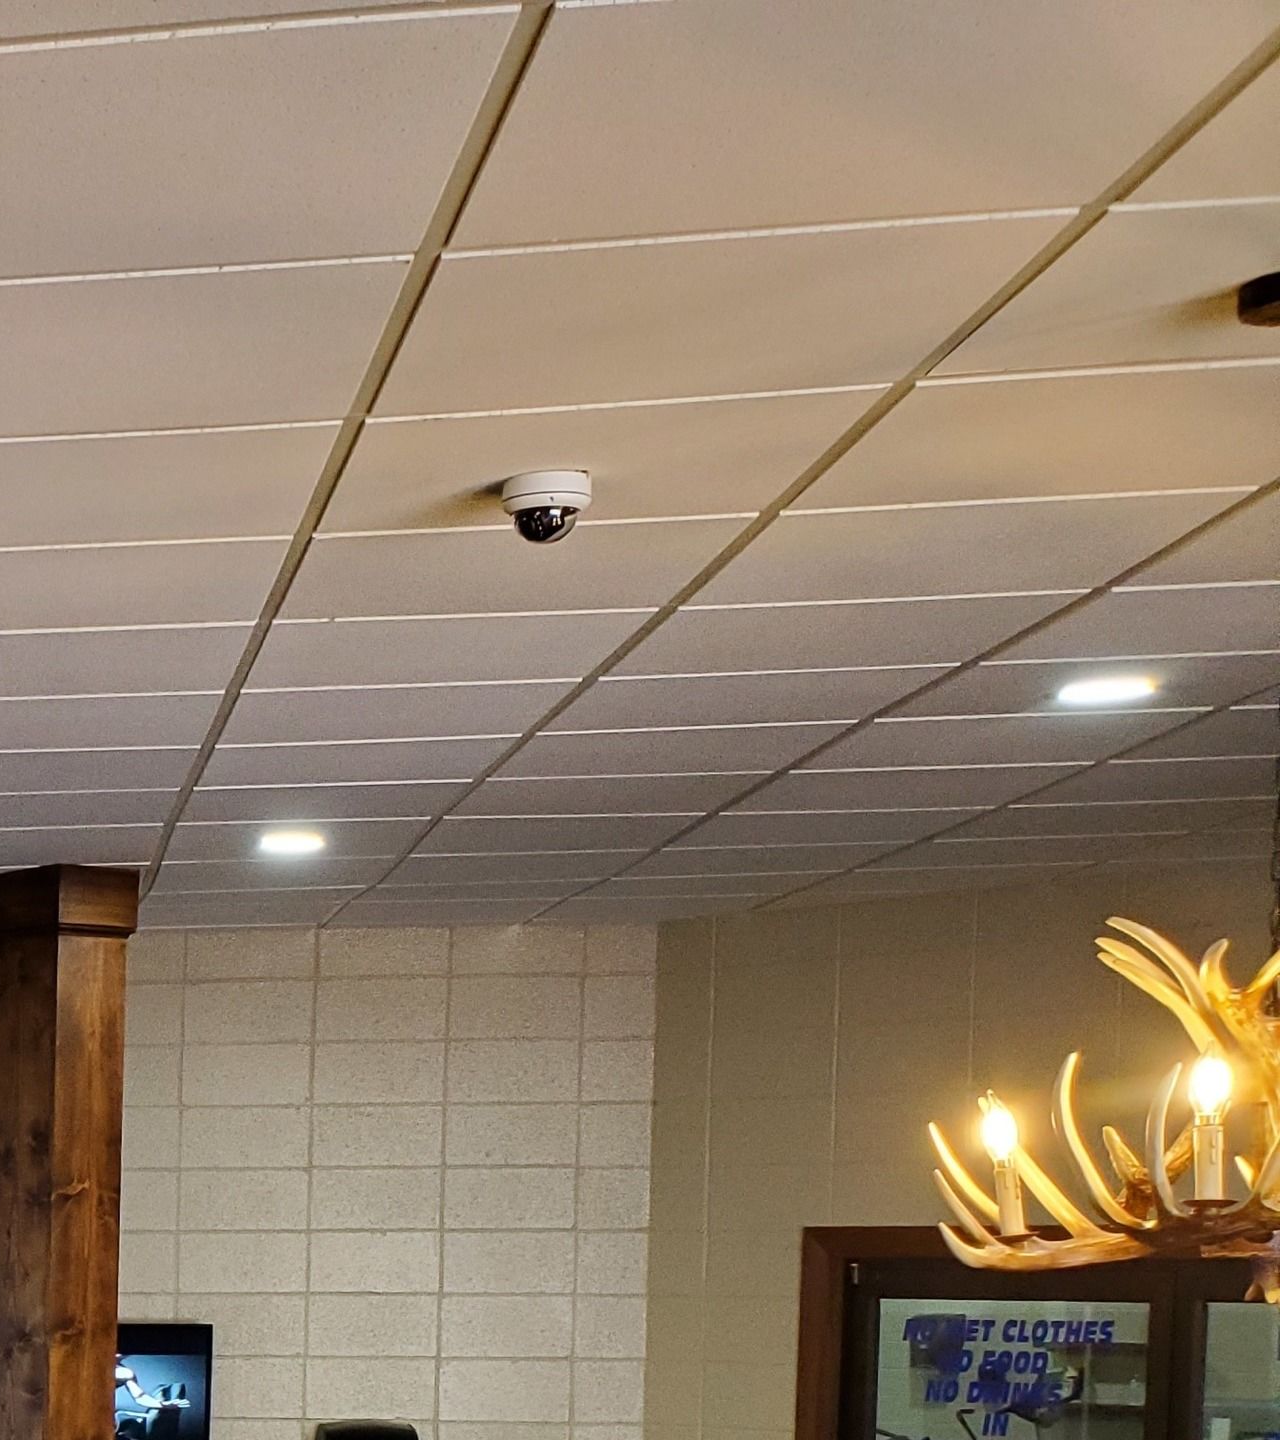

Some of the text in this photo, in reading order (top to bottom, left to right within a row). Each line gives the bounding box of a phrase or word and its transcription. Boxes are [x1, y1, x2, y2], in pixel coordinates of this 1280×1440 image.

[1002, 1319, 1115, 1343] CLOTHES
[982, 1350, 1048, 1375] FOOD
[925, 1379, 960, 1403] NO
[983, 1412, 1009, 1436] IN
